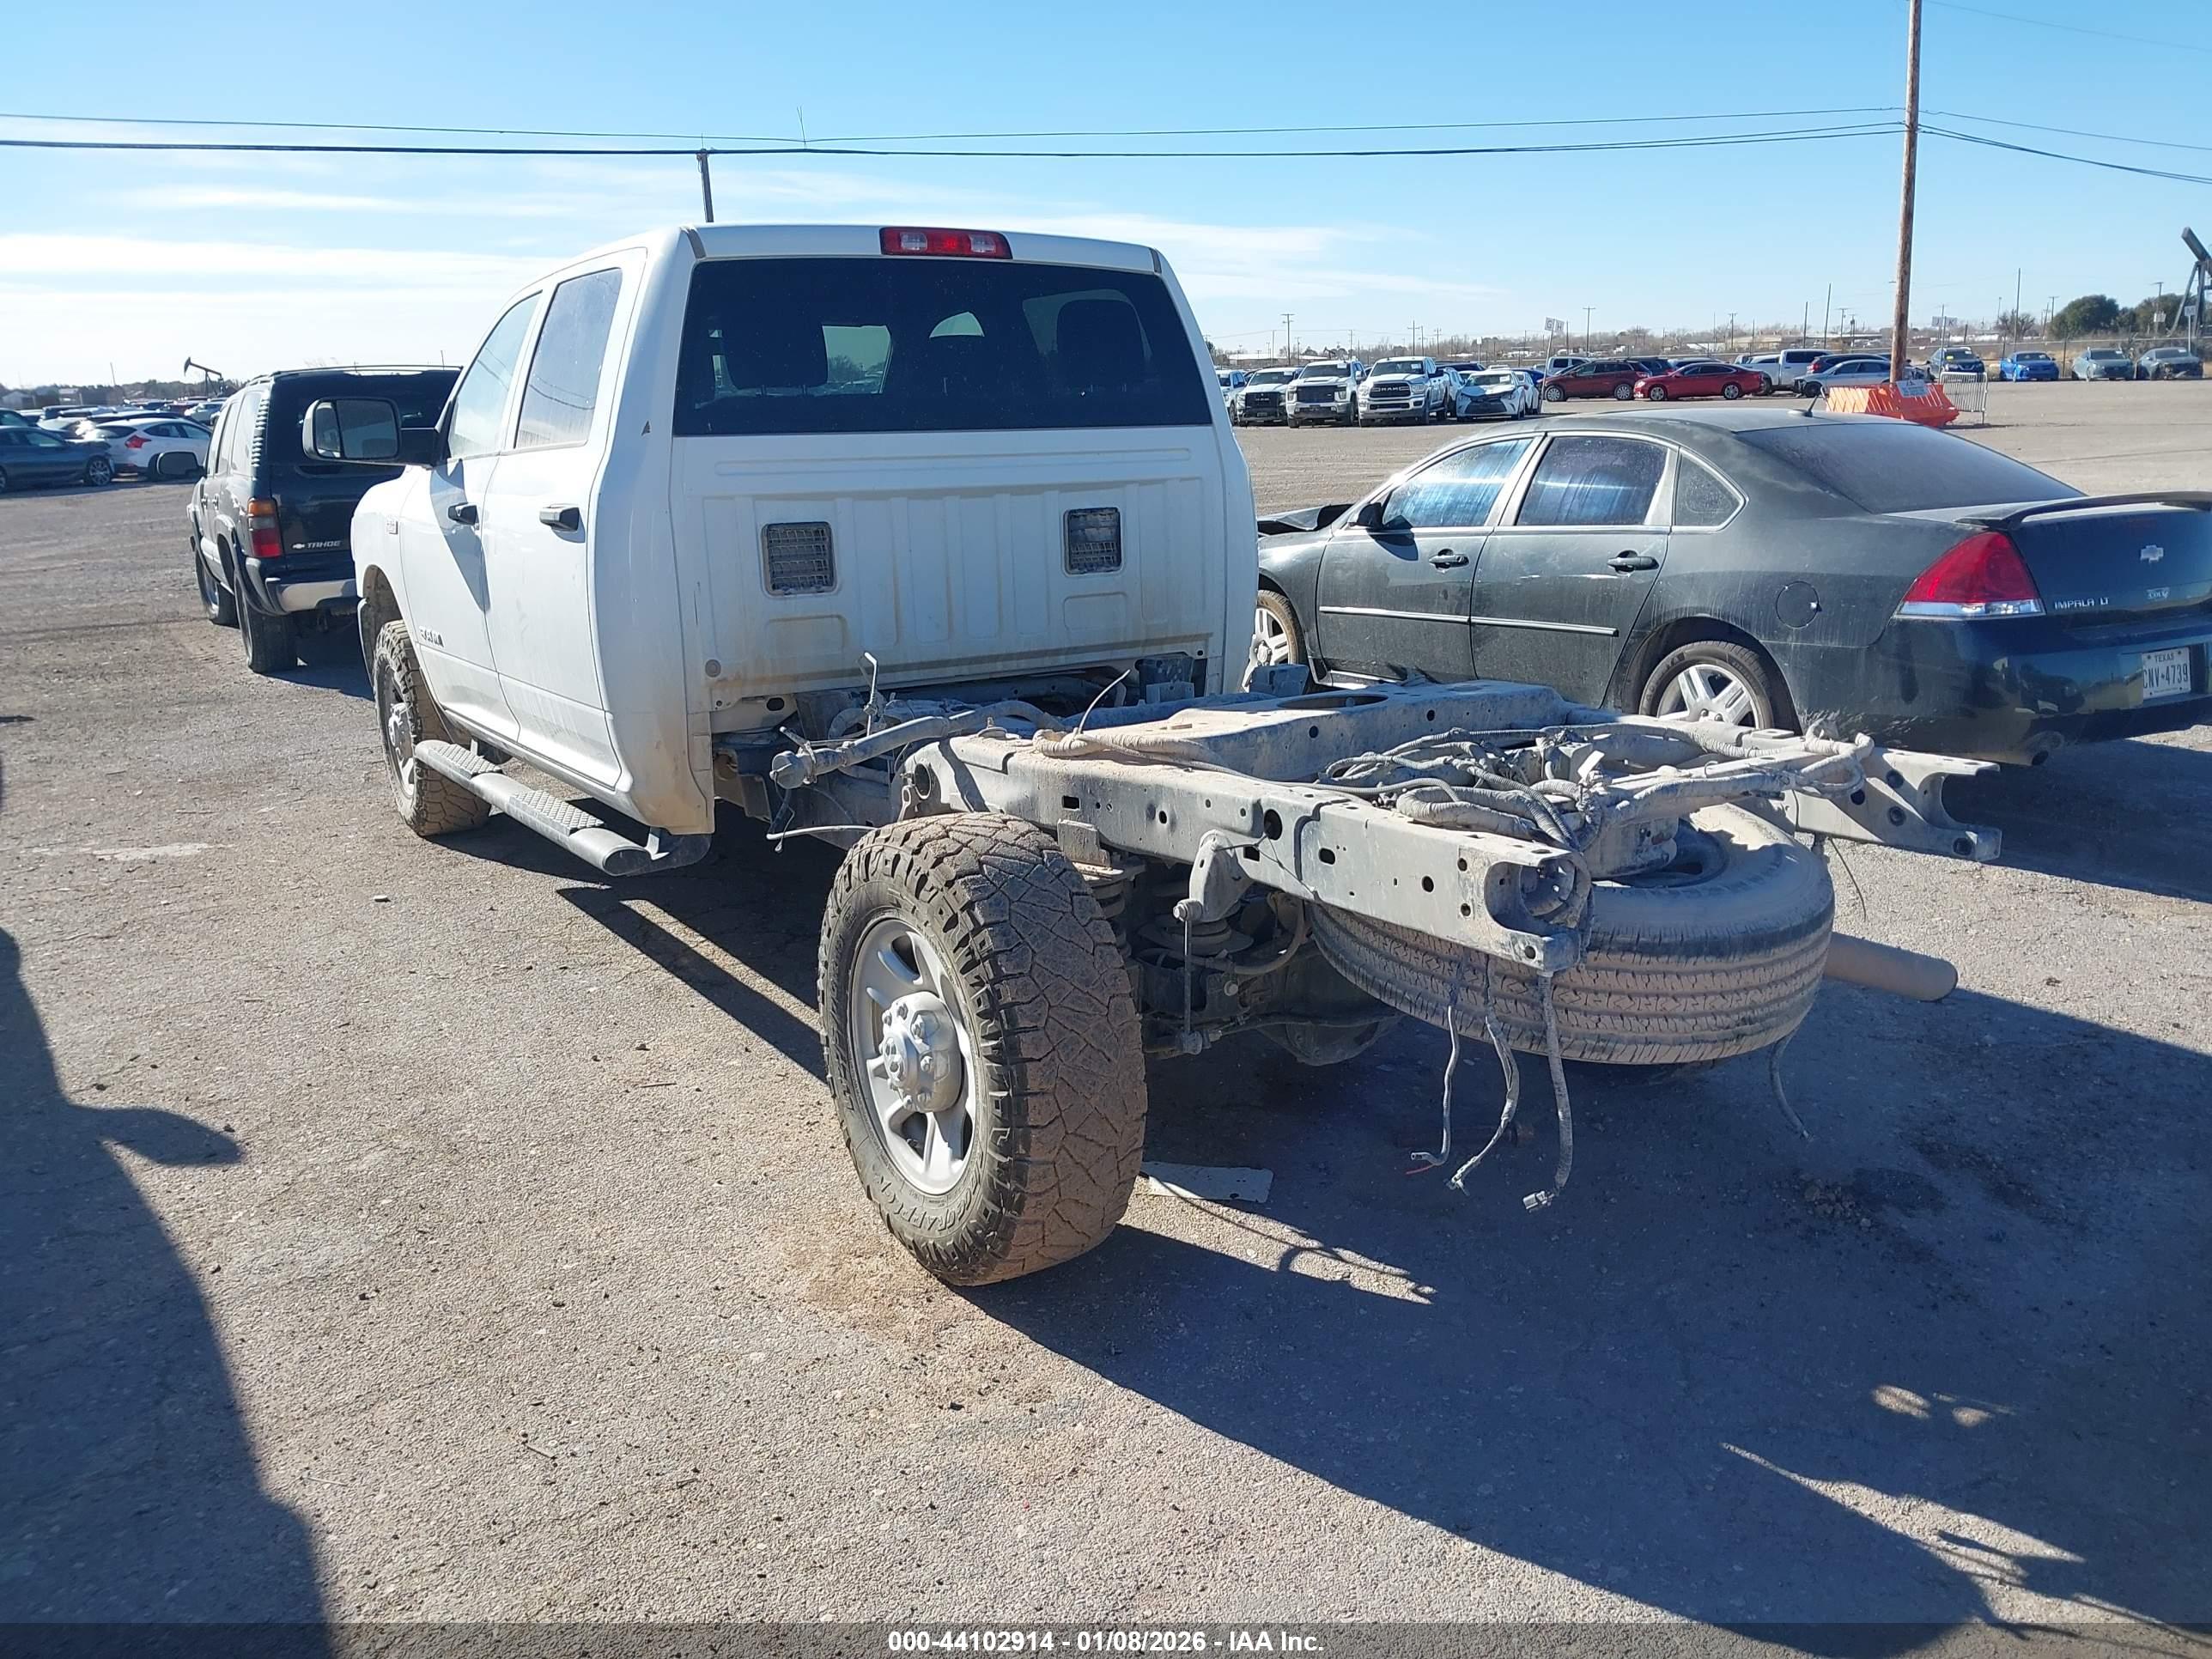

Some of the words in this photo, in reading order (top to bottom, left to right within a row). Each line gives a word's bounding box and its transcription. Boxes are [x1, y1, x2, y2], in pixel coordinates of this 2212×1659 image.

[307, 540, 341, 549] TAHOE
[2054, 598, 2095, 610] IMPALA
[2154, 653, 2174, 663] TEXAS
